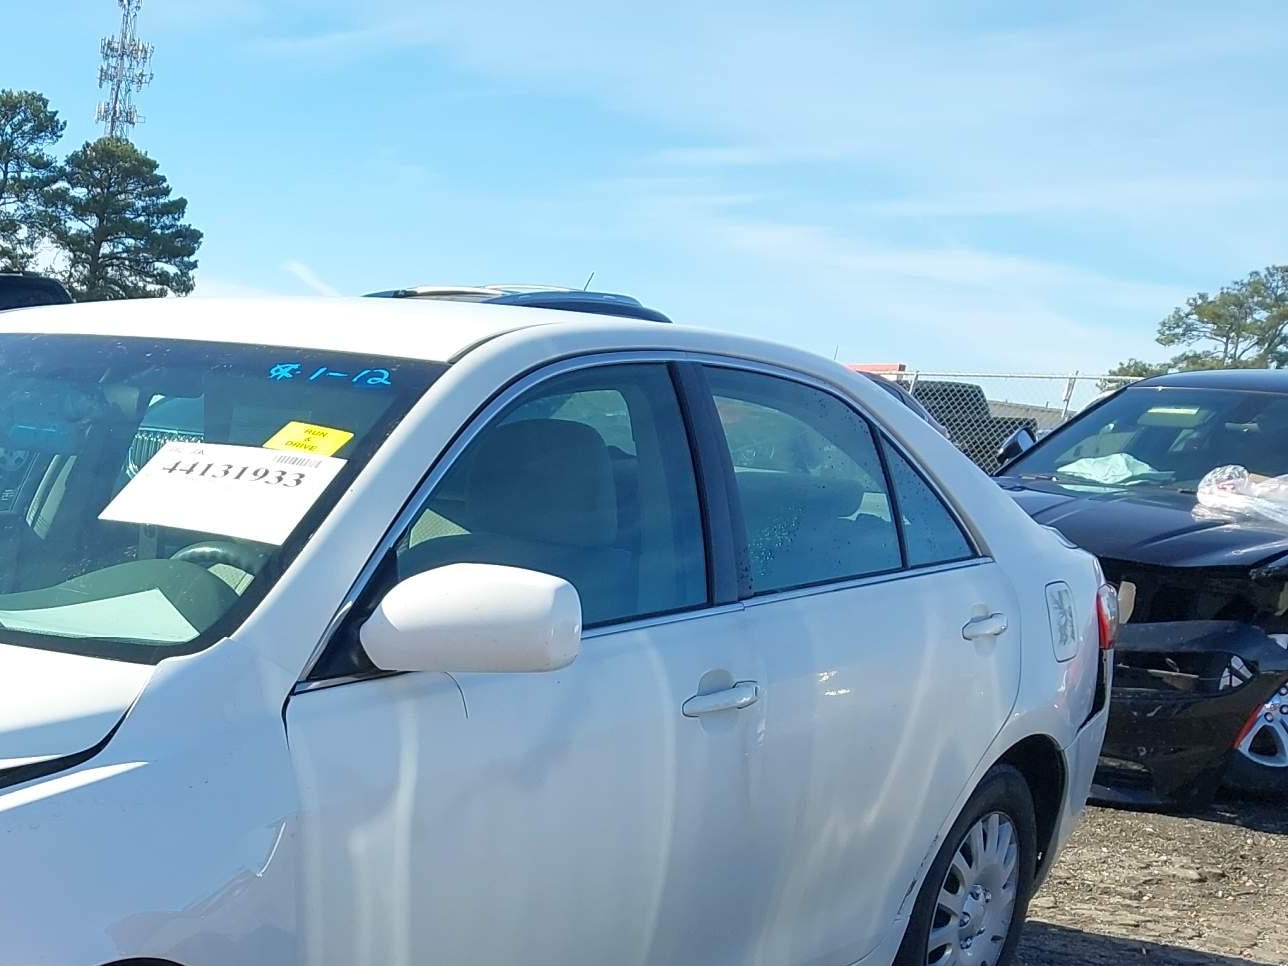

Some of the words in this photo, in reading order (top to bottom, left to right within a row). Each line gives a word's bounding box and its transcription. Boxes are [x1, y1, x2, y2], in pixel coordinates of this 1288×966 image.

[304, 428, 329, 438] RUN
[284, 440, 318, 451] DRIVE
[162, 460, 305, 488] 44131933
